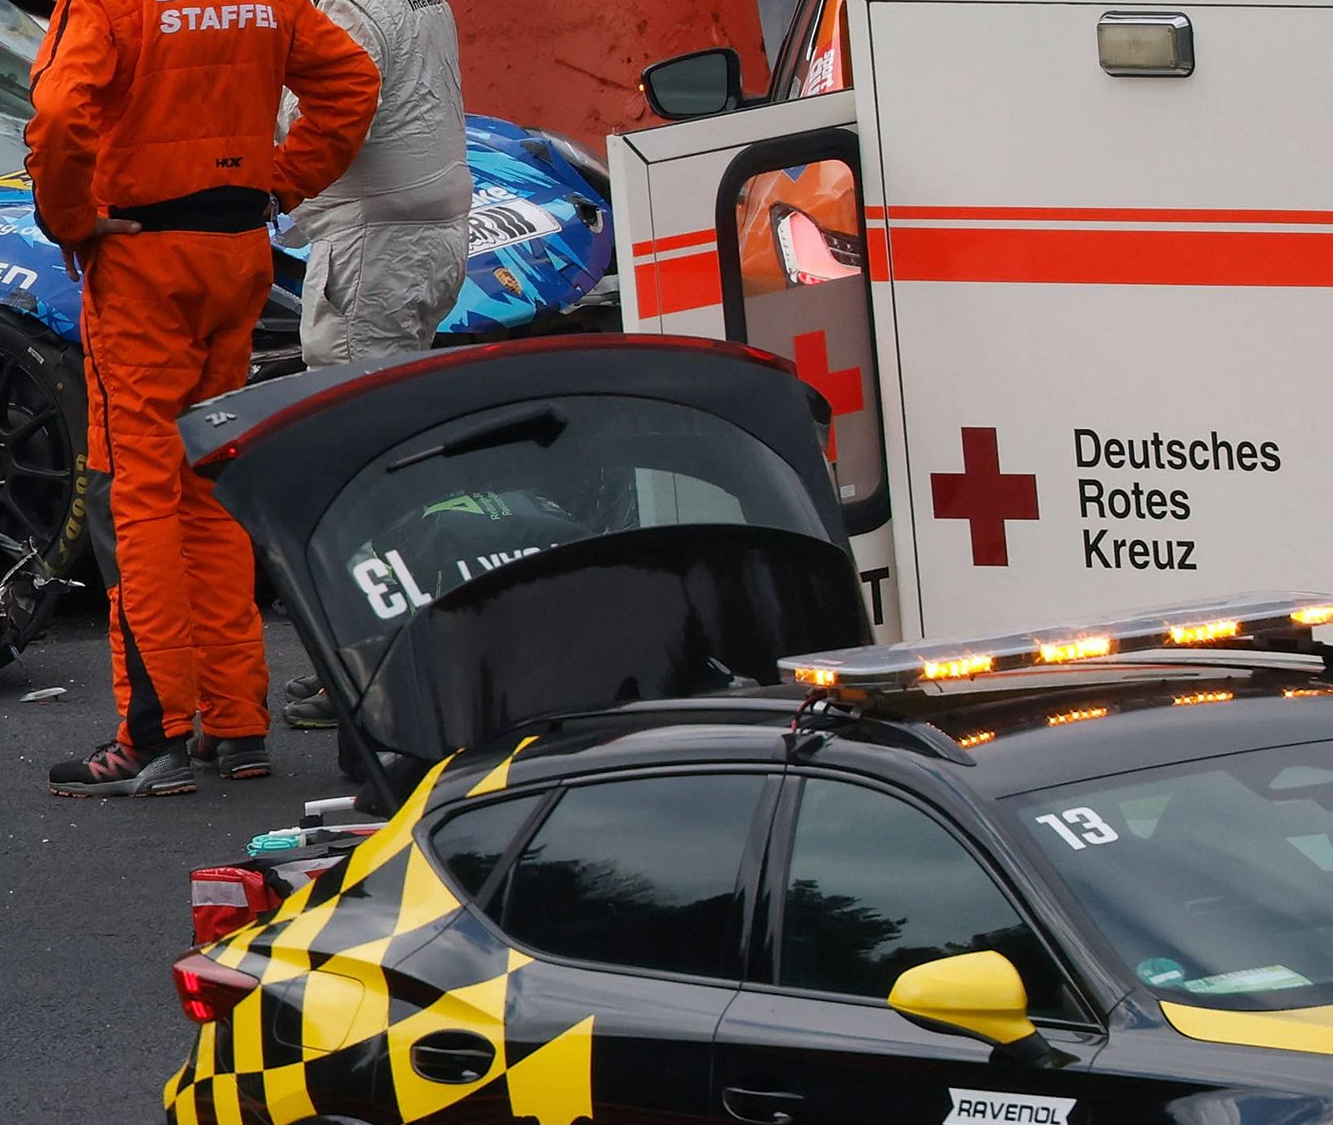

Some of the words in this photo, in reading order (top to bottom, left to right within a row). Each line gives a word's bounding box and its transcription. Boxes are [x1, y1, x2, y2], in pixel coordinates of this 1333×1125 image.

[159, 4, 278, 35] STAFFEL
[1073, 428, 1282, 473] Deutsches
[1077, 478, 1192, 521] Rotes
[1083, 529, 1198, 572] Kreuz
[1035, 806, 1120, 851] 13
[957, 1098, 1062, 1125] RAVENOL
